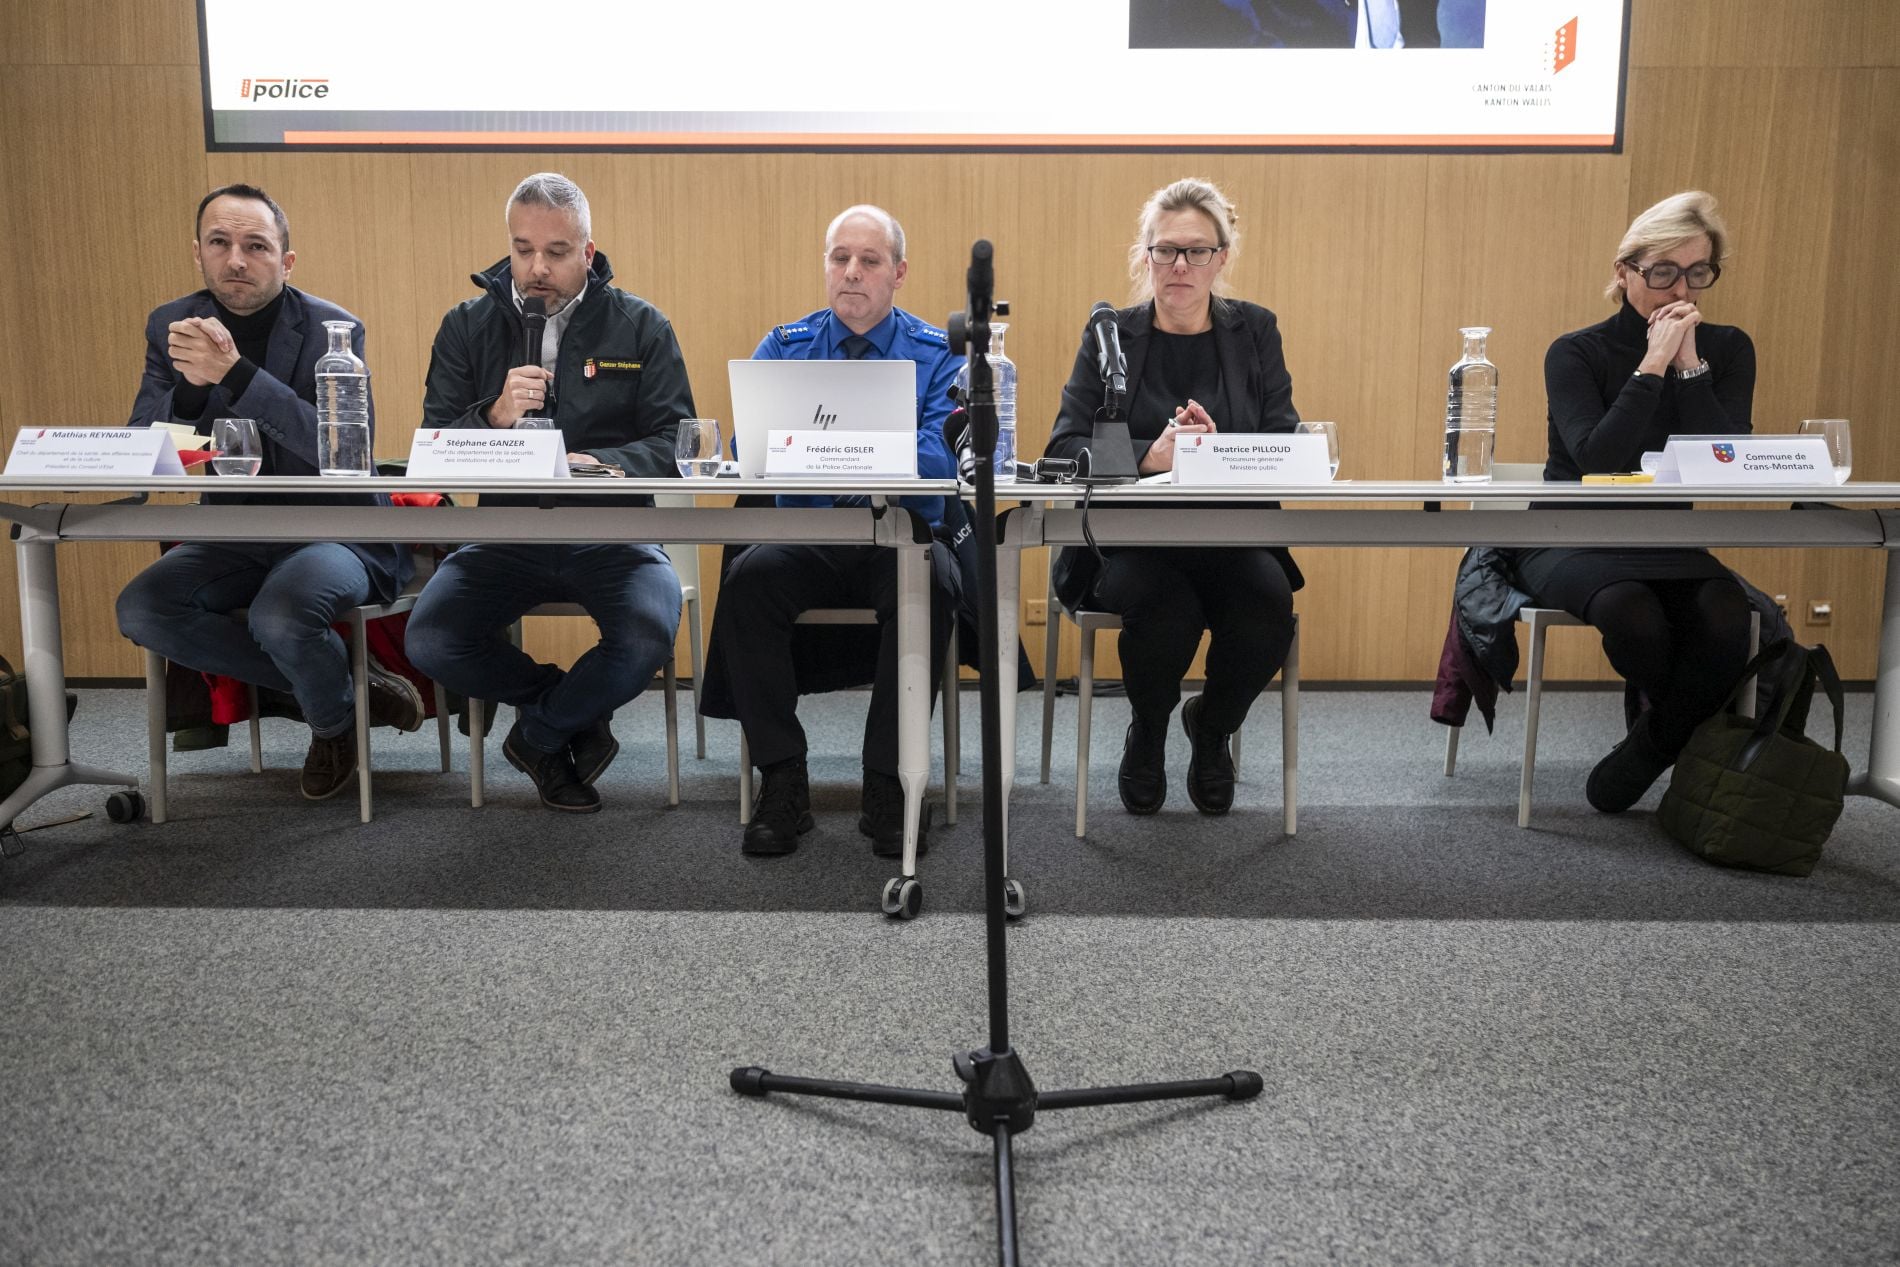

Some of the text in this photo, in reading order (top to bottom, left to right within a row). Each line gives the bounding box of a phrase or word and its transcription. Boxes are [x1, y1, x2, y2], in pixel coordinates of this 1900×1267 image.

[253, 79, 329, 102] police
[52, 431, 87, 439] Mathias
[446, 439, 487, 448] Stéphane
[806, 445, 842, 453] Frédéric
[1213, 445, 1250, 453] Beatrice
[1746, 453, 1792, 461] Commune
[1743, 463, 1815, 471] Crans-Montana
[953, 522, 973, 548] LICE
